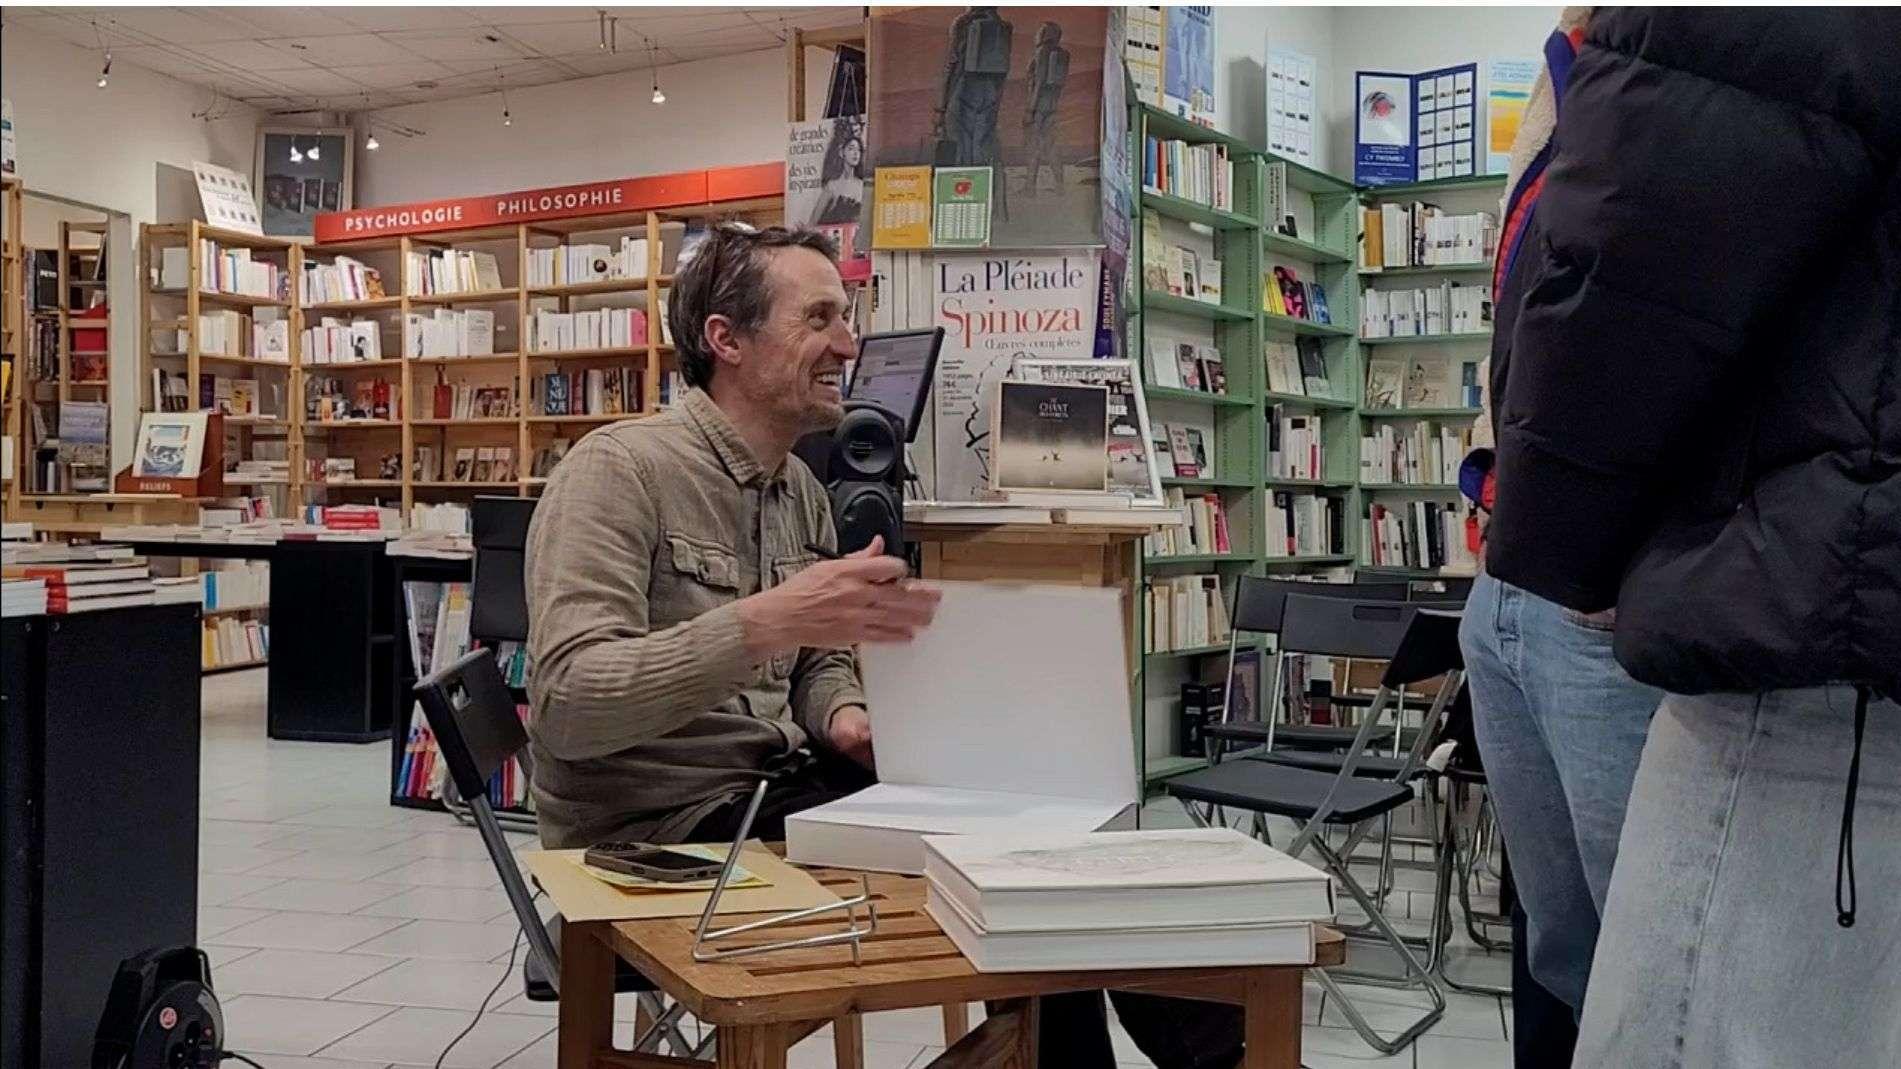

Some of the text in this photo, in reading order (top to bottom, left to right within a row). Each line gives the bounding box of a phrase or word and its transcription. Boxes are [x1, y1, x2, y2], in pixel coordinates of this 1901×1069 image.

[345, 188, 622, 231] PSYCHOLOGIE PHILOSOPHIE
[940, 257, 1083, 294] La Pléiade
[941, 297, 1082, 349] Spinoza
